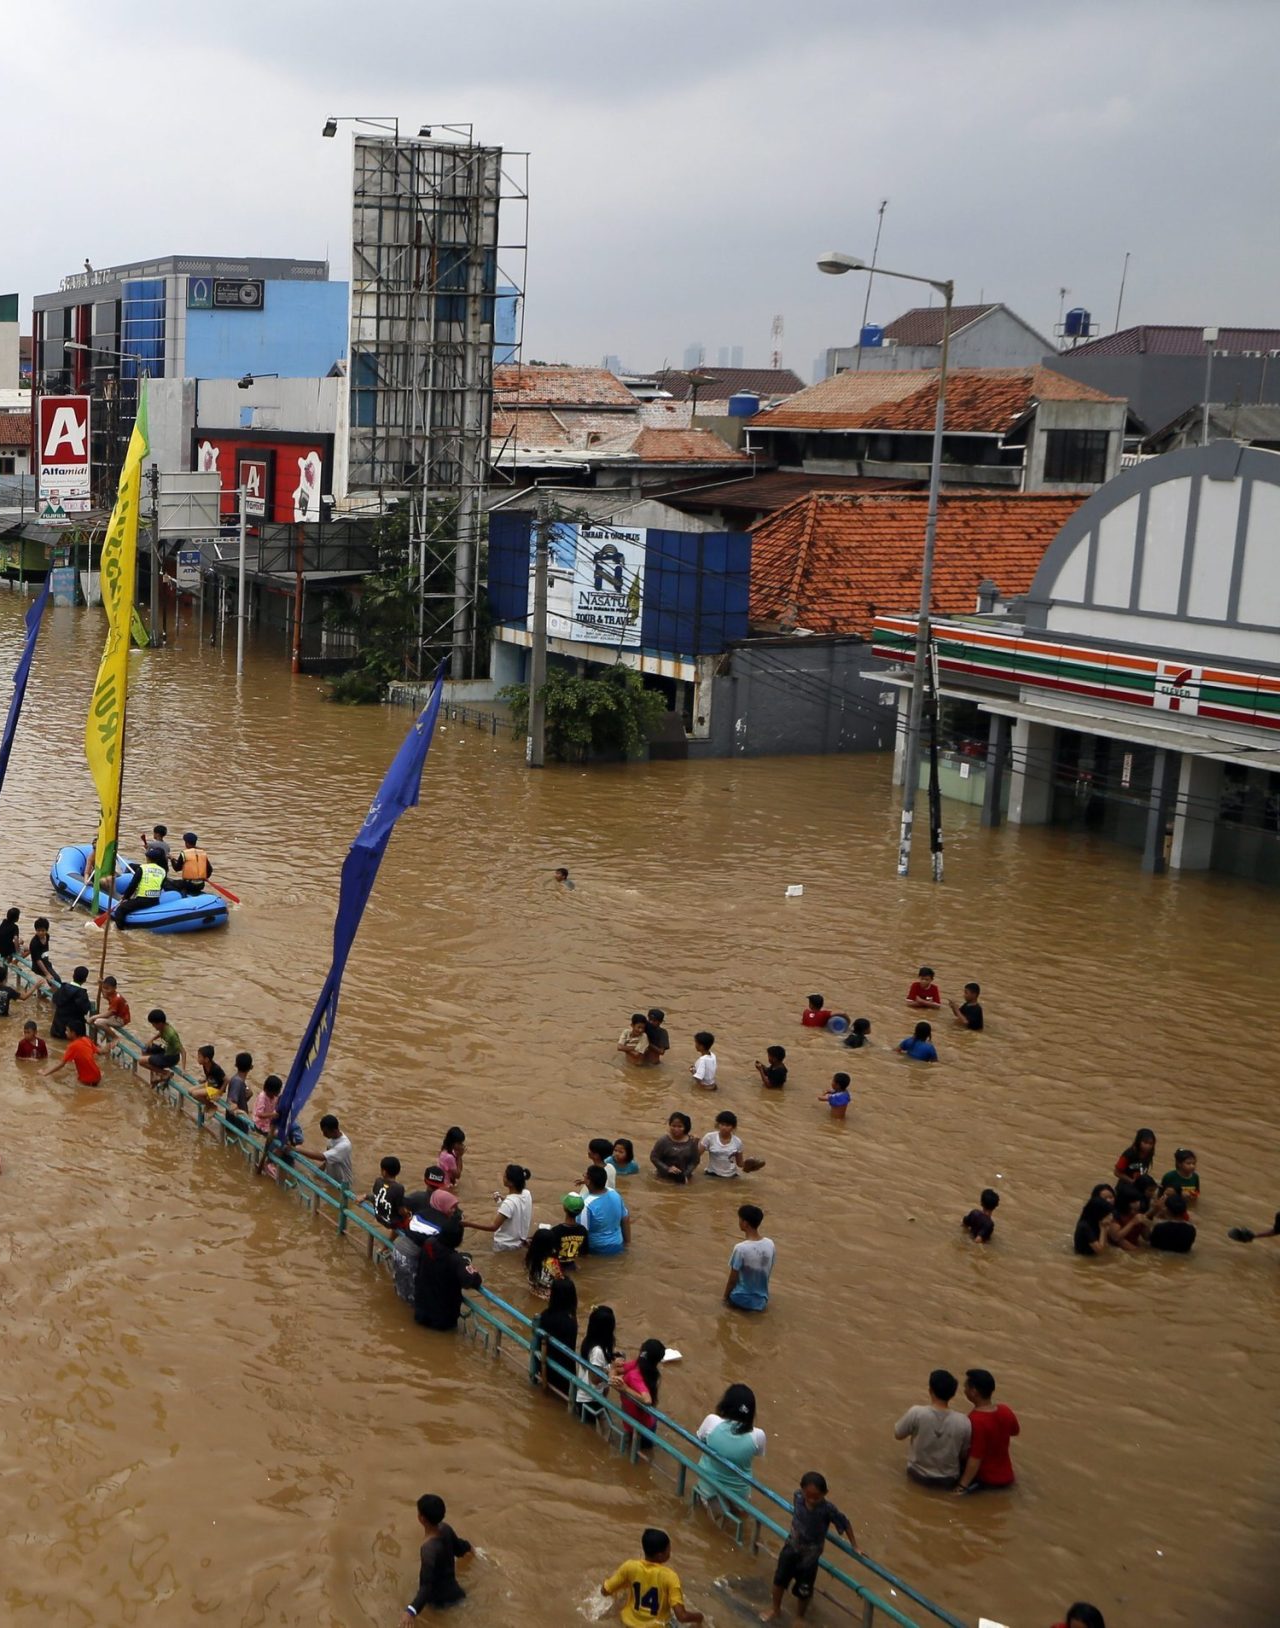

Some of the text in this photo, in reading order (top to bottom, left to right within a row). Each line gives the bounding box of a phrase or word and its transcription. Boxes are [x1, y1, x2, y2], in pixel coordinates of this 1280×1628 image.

[42, 466, 88, 475] Alfamidi
[576, 613, 596, 624] TOUR
[632, 1581, 660, 1616] 14
